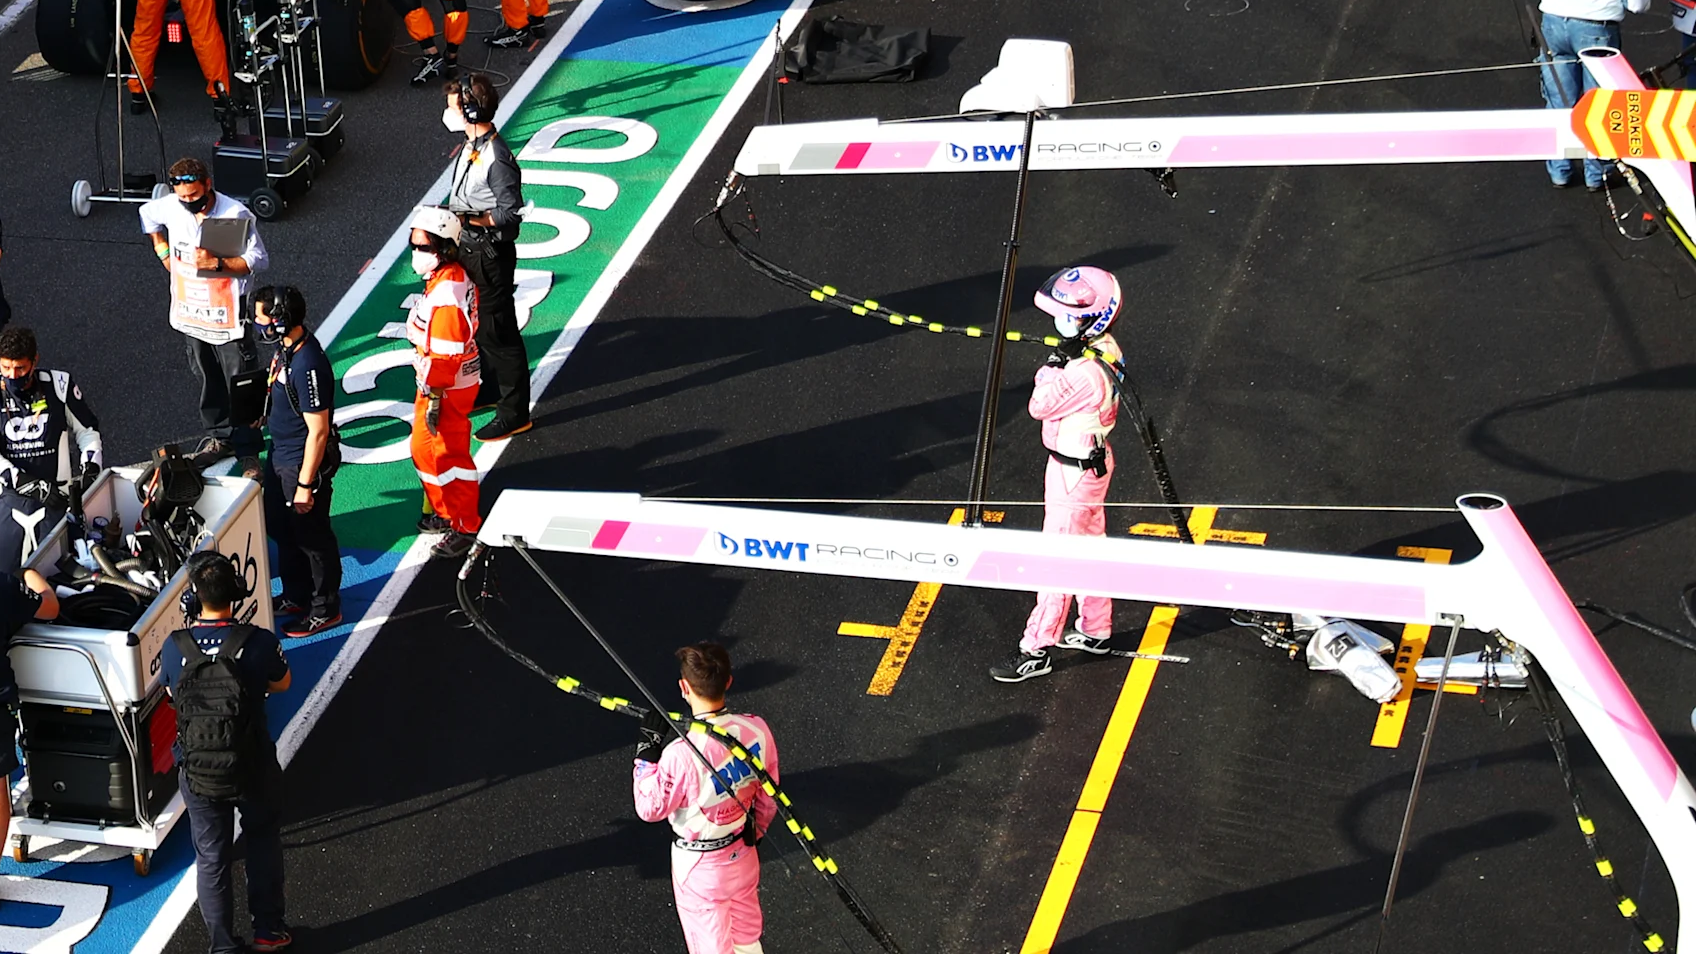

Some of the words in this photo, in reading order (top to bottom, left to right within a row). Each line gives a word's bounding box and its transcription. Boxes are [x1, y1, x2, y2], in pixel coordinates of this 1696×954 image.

[1610, 110, 1623, 133] ON
[1627, 92, 1643, 156] BRAKES
[1038, 142, 1143, 154] RACING
[1093, 296, 1118, 333] BWT
[745, 537, 810, 564] BWT
[815, 543, 937, 565] RACING
